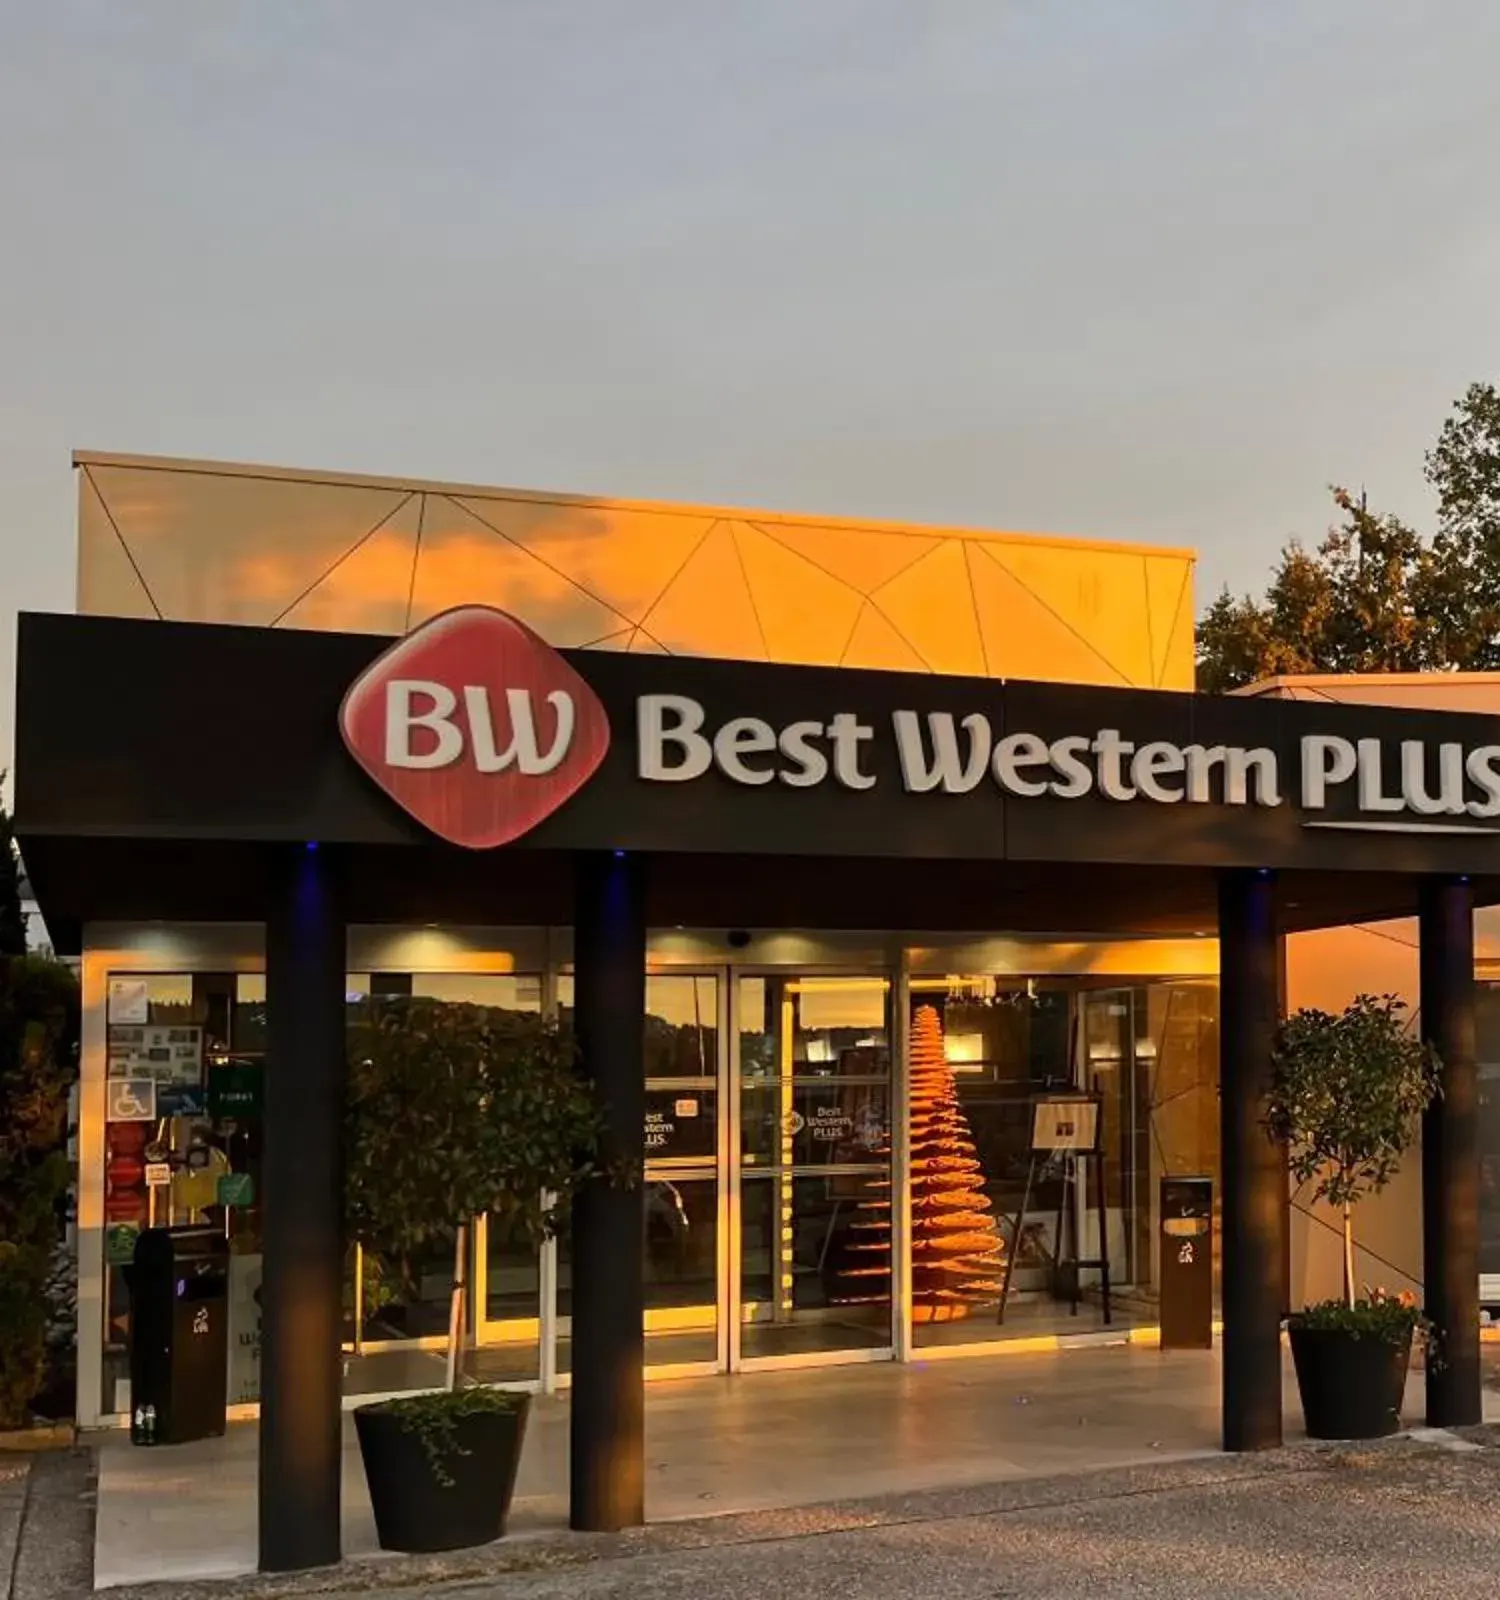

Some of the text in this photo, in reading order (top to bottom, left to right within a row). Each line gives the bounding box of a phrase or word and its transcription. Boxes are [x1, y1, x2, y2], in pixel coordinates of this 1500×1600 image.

[384, 679, 575, 775] BW
[636, 693, 877, 789] Best
[891, 709, 1283, 807] Western
